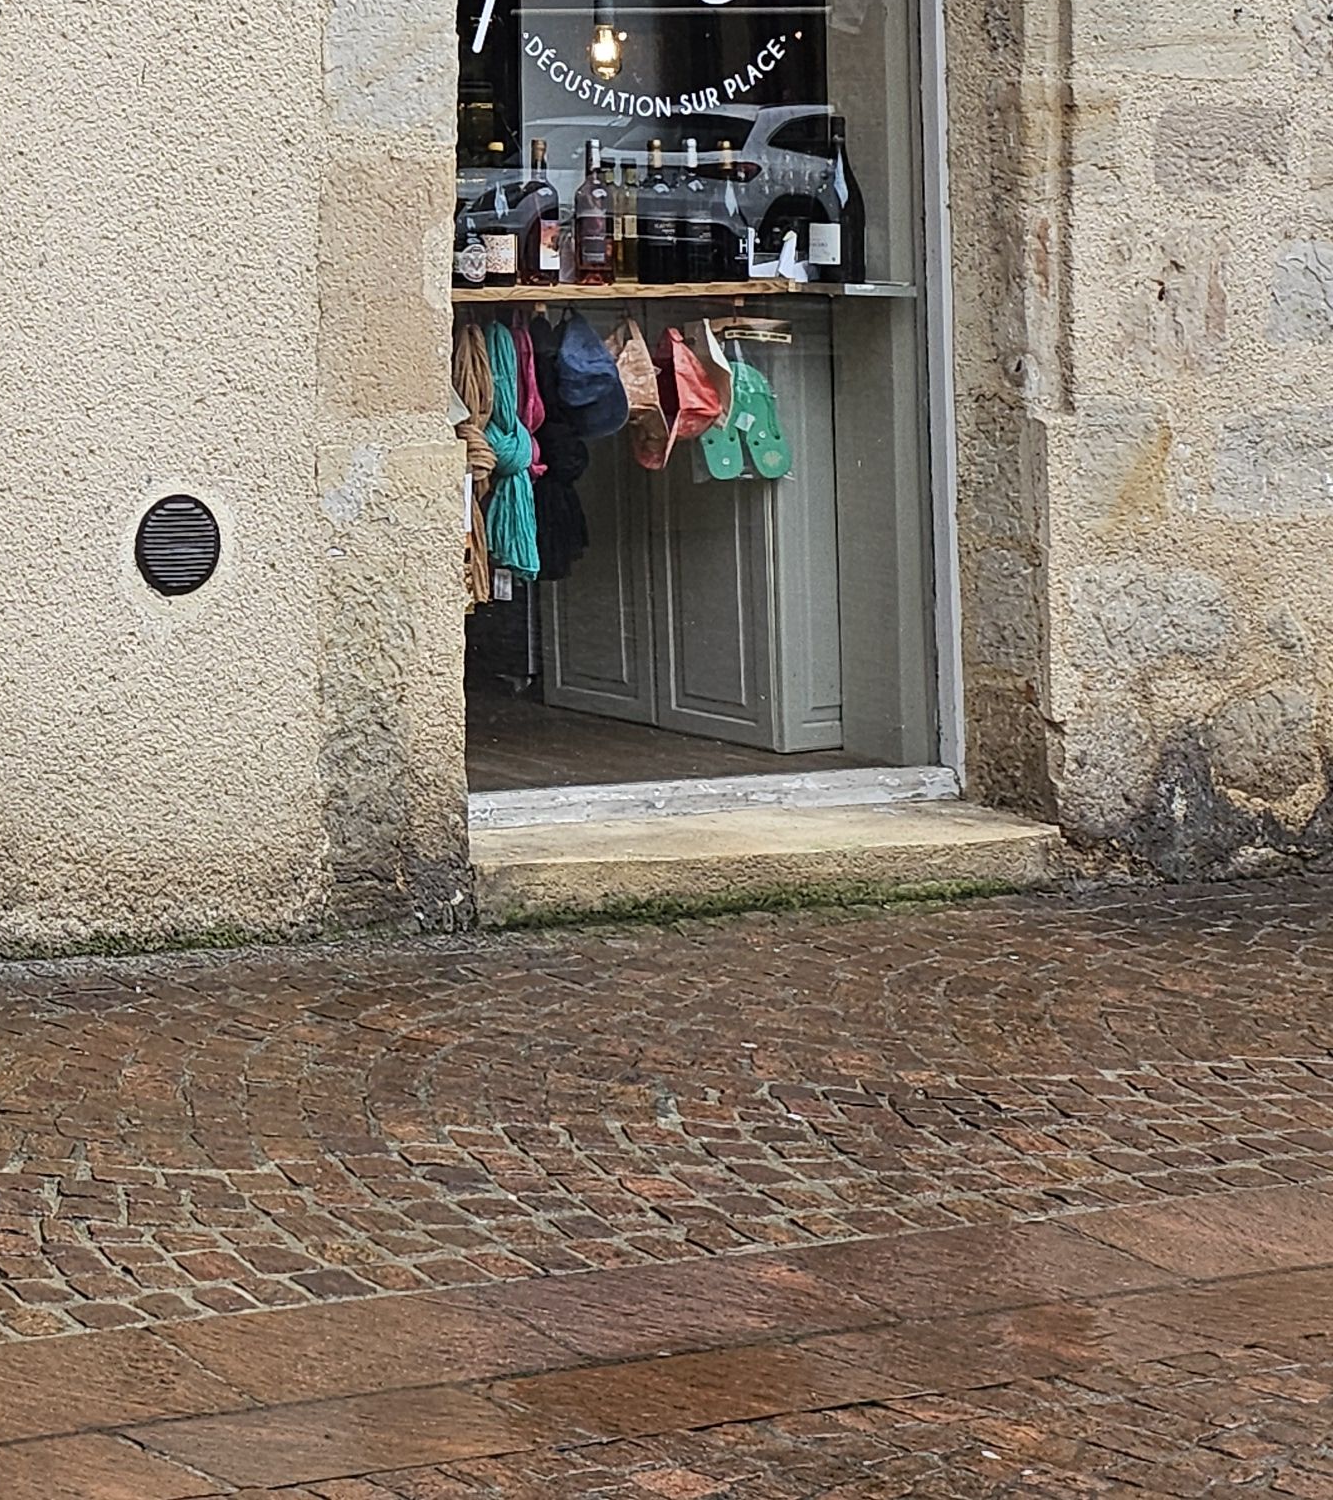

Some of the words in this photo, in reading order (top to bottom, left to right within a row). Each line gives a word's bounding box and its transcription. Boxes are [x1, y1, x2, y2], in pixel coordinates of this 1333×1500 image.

[524, 33, 672, 118] DÉGUSTATION
[679, 86, 720, 115] SUR
[724, 37, 785, 101] PLACE
